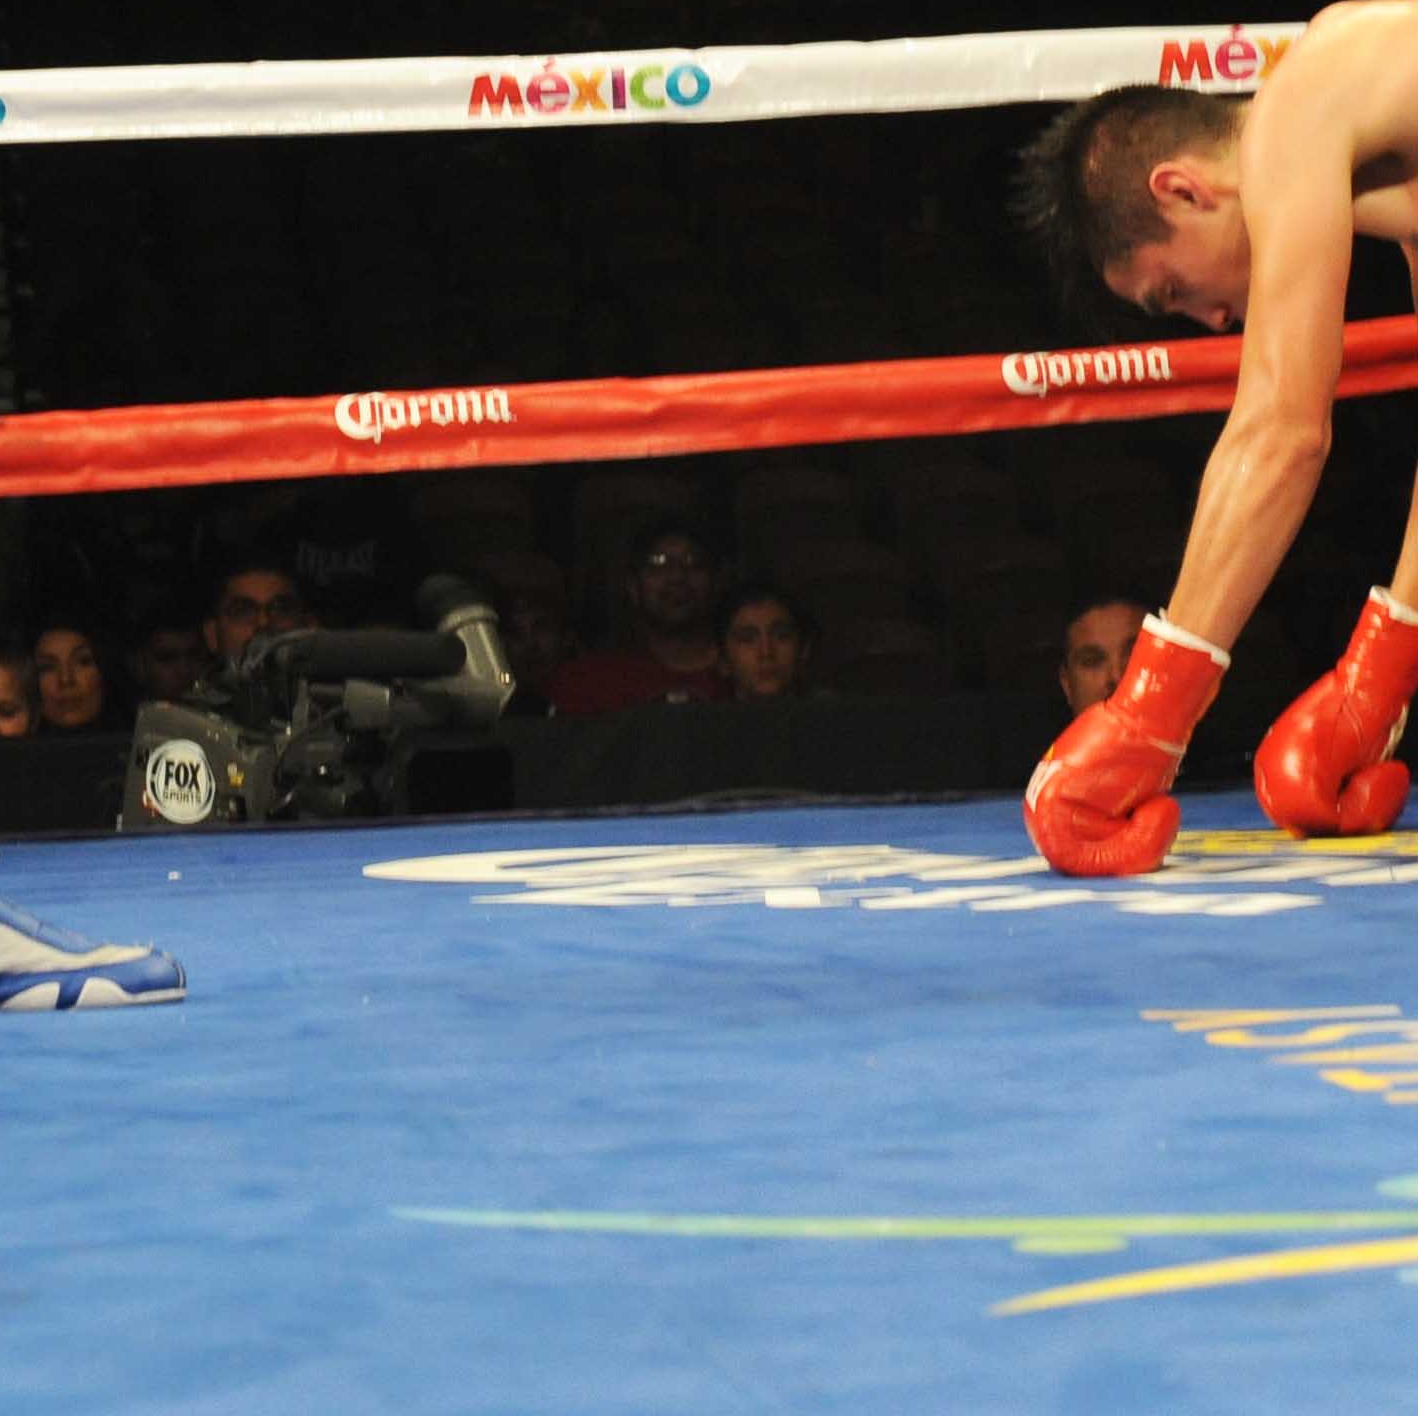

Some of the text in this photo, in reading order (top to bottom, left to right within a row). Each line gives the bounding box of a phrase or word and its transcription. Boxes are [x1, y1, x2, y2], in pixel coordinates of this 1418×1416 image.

[1158, 24, 1292, 88] MéX
[1002, 346, 1172, 398] Corona
[334, 389, 513, 445] Corona
[164, 760, 201, 792] FOX
